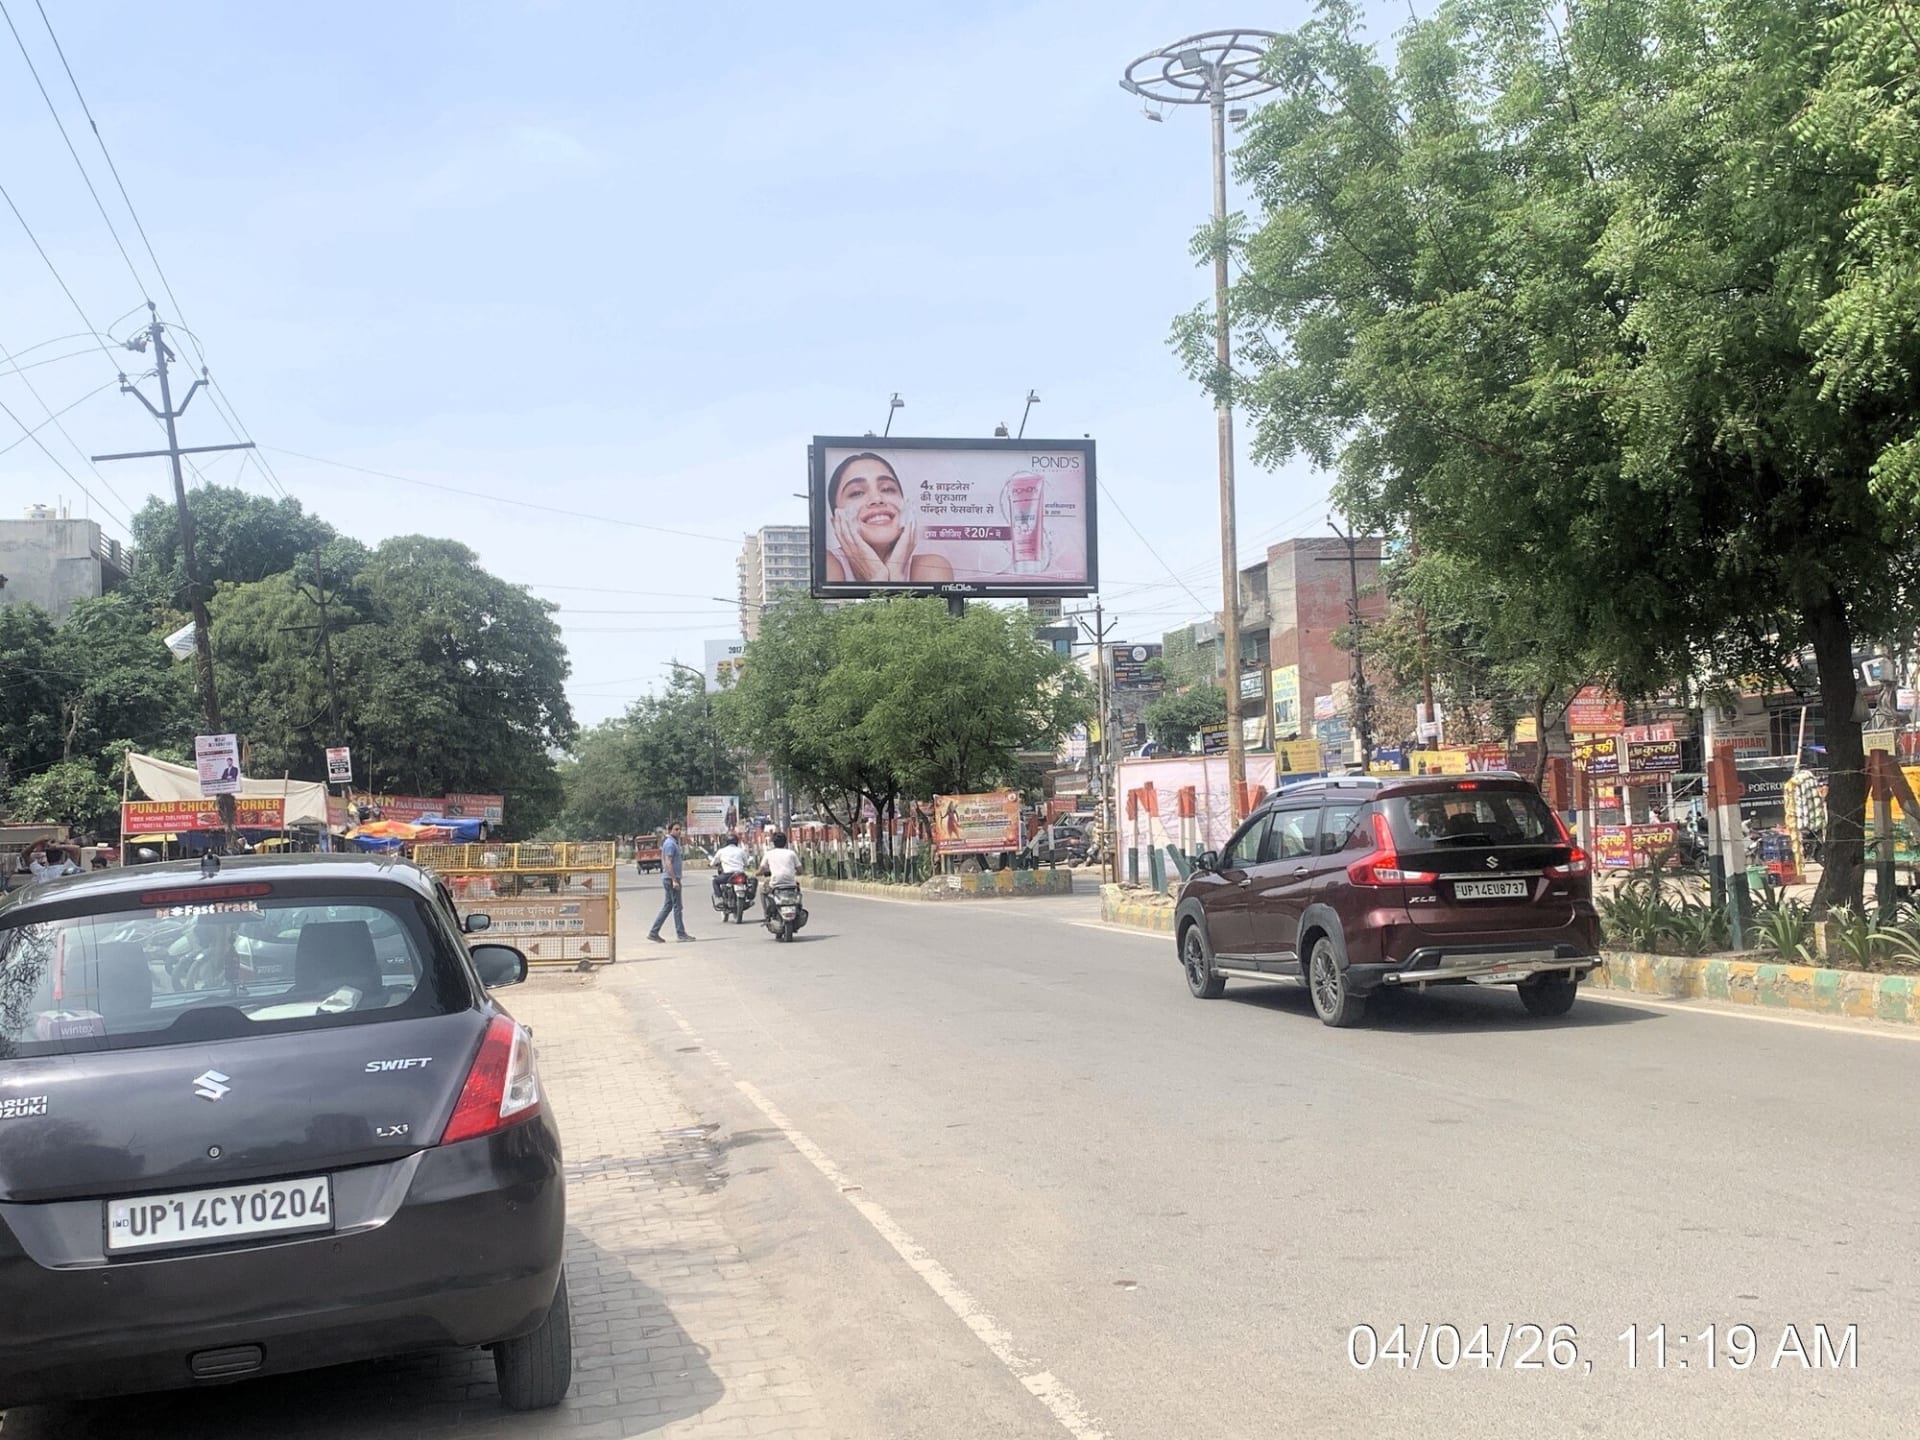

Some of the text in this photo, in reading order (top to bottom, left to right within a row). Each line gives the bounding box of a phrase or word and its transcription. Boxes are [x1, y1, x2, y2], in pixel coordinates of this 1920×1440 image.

[1031, 456, 1079, 468] POND'S
[920, 491, 931, 501] की
[986, 503, 994, 513] से
[129, 799, 280, 814] PUNJAB CHICK CORNER
[1461, 882, 1525, 897] UP14EU8737
[526, 904, 555, 918] पुलिस
[365, 1057, 432, 1072] SWIFT
[0, 1095, 48, 1108] RUTI
[0, 1104, 47, 1118] ZUKI
[130, 1185, 326, 1236] UP14CY0204
